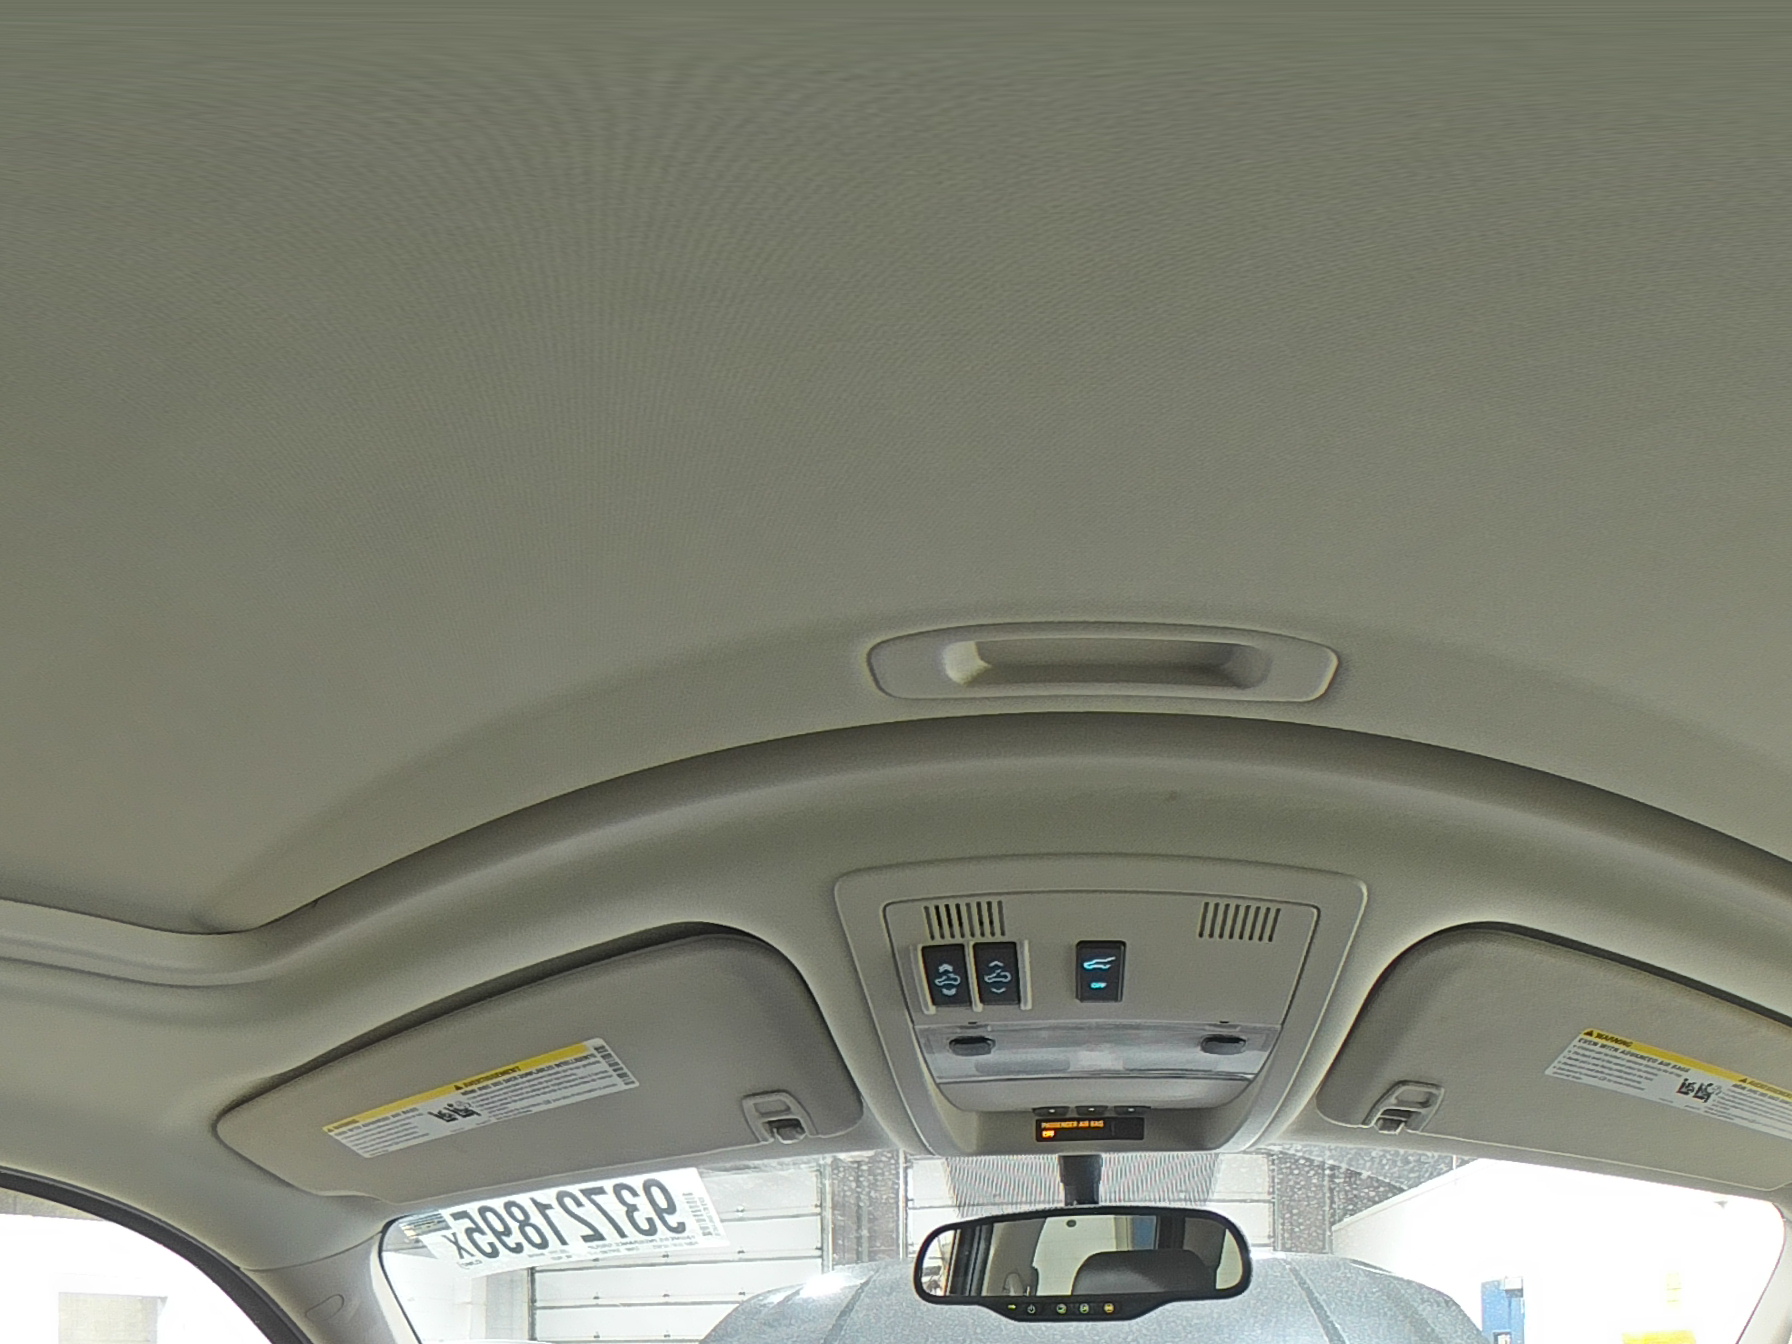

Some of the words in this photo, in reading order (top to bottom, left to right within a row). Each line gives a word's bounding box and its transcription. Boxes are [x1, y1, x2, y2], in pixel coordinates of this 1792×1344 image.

[1595, 1031, 1634, 1048] WARNING
[1041, 1121, 1078, 1129] PASSENGER
[1078, 1120, 1089, 1128] AIR
